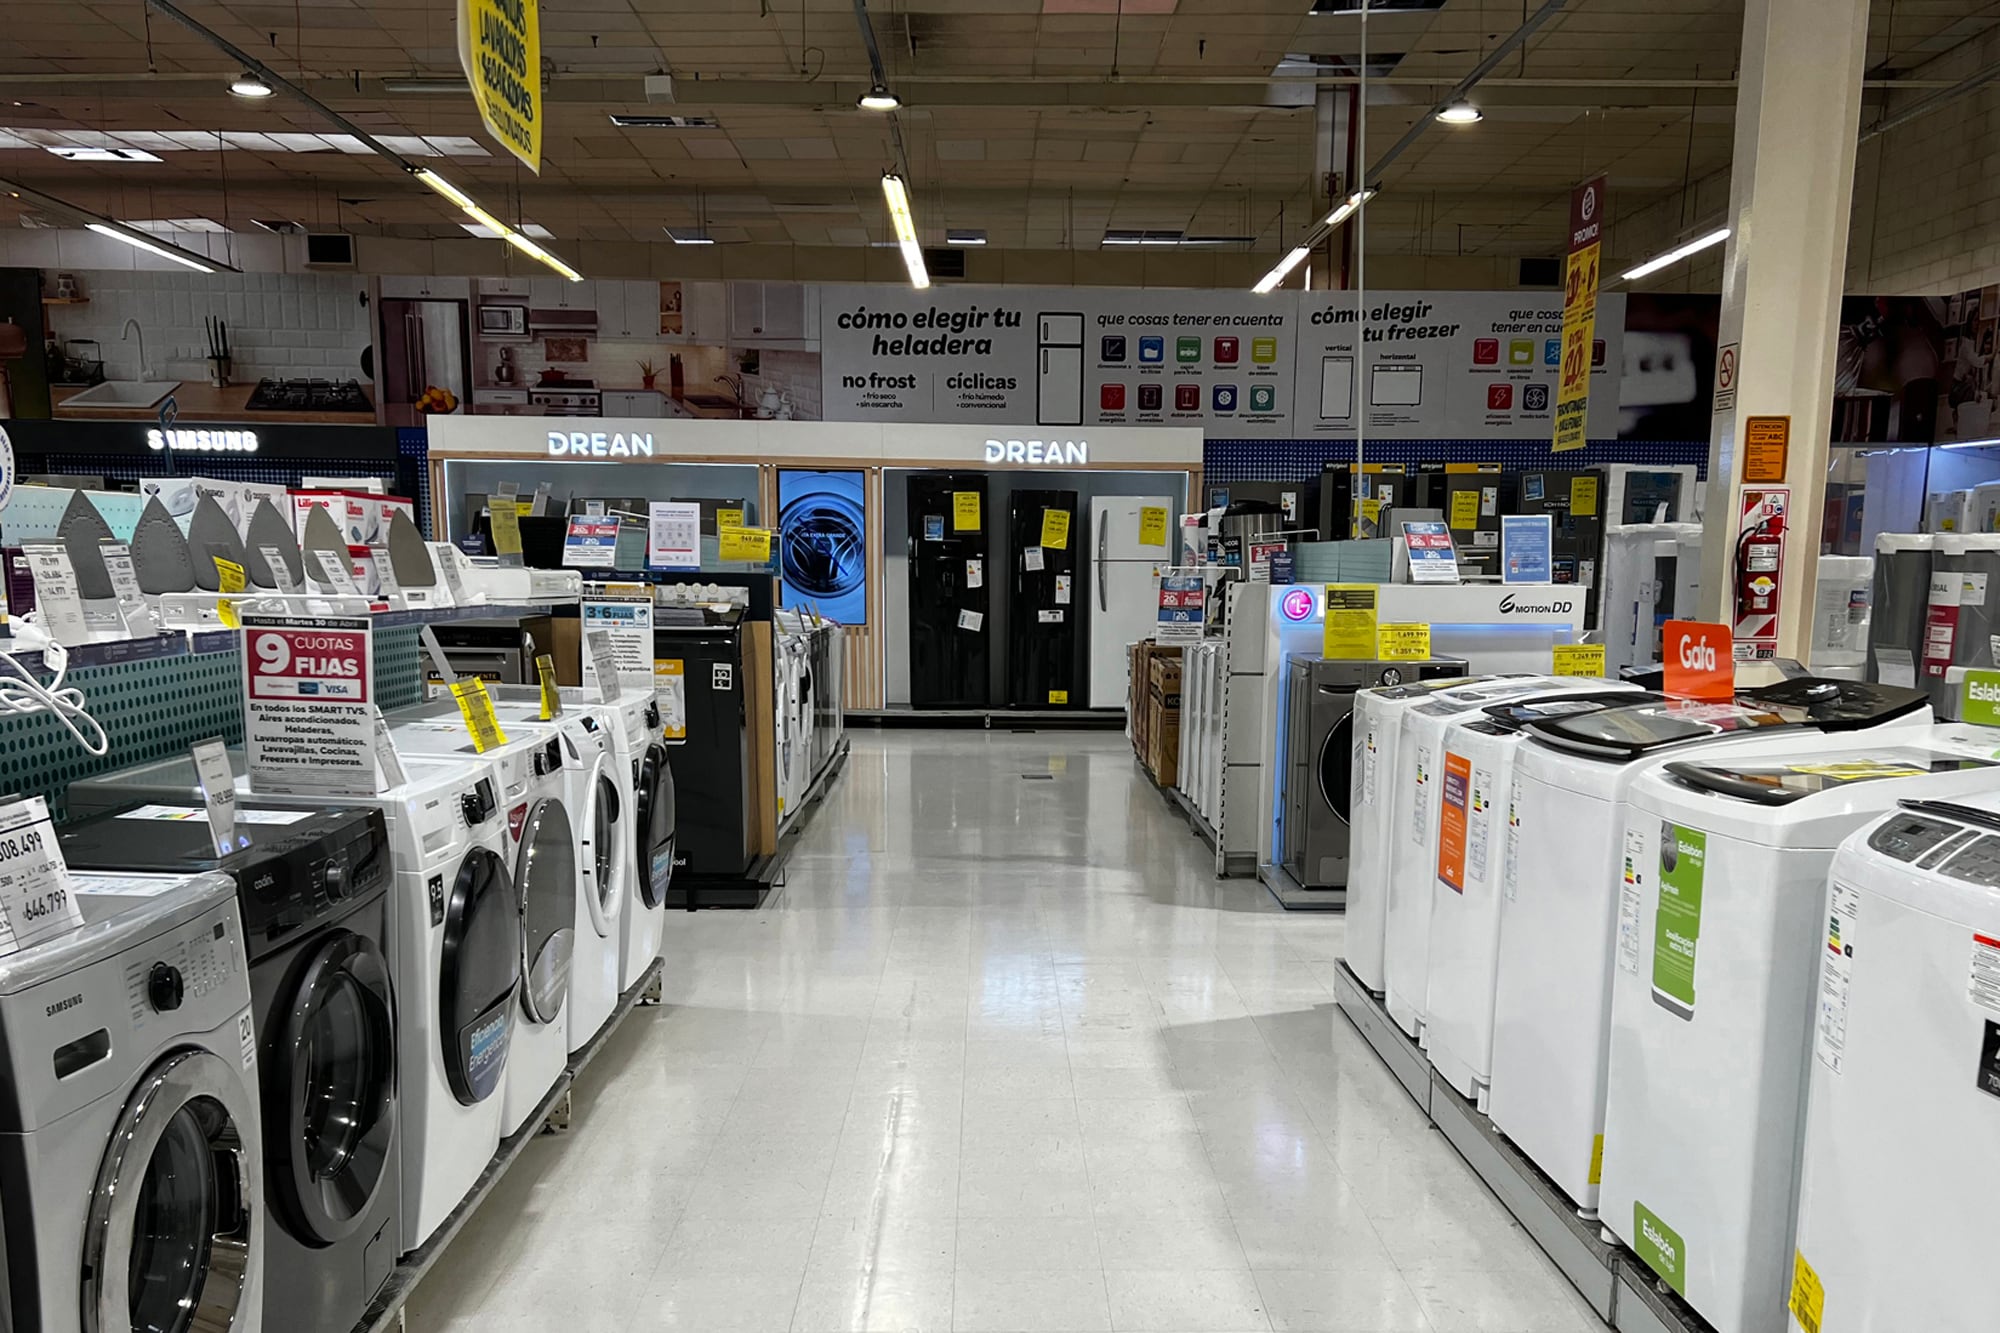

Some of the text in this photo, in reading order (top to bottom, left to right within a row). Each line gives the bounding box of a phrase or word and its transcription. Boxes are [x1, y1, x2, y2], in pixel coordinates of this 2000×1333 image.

[1311, 300, 1432, 324] cómo elegir
[1509, 309, 1534, 322] que
[837, 306, 1021, 333] cómo elegir tu
[1097, 314, 1284, 328] que cosas tener en cuenta
[1363, 323, 1460, 342] tu freezer
[1491, 321, 1526, 333] tener
[1527, 323, 1543, 333] en
[872, 333, 992, 356] heladera
[1325, 344, 1352, 352] vertical
[1380, 353, 1416, 361] horizontal
[842, 372, 916, 389] no frost
[946, 372, 1017, 390] cíclicas
[548, 431, 653, 456] DREAN
[985, 440, 1087, 464] DREAN
[587, 607, 596, 618] 3
[602, 607, 612, 618] 6
[1552, 602, 1572, 613] DD
[253, 617, 275, 625] Hasta
[286, 618, 313, 627] Martes
[294, 636, 354, 651] CUOTAS
[255, 633, 291, 674] 9
[1680, 634, 1716, 672] Gafa
[295, 656, 358, 677] FIJAS
[324, 684, 348, 694] VISA
[1968, 681, 2000, 702] Eslab
[250, 704, 263, 712] En
[264, 704, 290, 713] todos
[292, 704, 306, 713] los
[308, 705, 342, 714] SMART
[259, 714, 360, 725] Aires acondicionados,
[285, 725, 334, 735] Heladeras,
[254, 735, 367, 746] Lavarropas automáticos,
[262, 745, 360, 756] Lavavajillas, Cocinas,
[260, 755, 299, 764] Freezers
[308, 756, 363, 766] Impresoras.
[46, 993, 83, 1017] SAMSUNG
[1642, 1218, 1675, 1261] Eslabón
